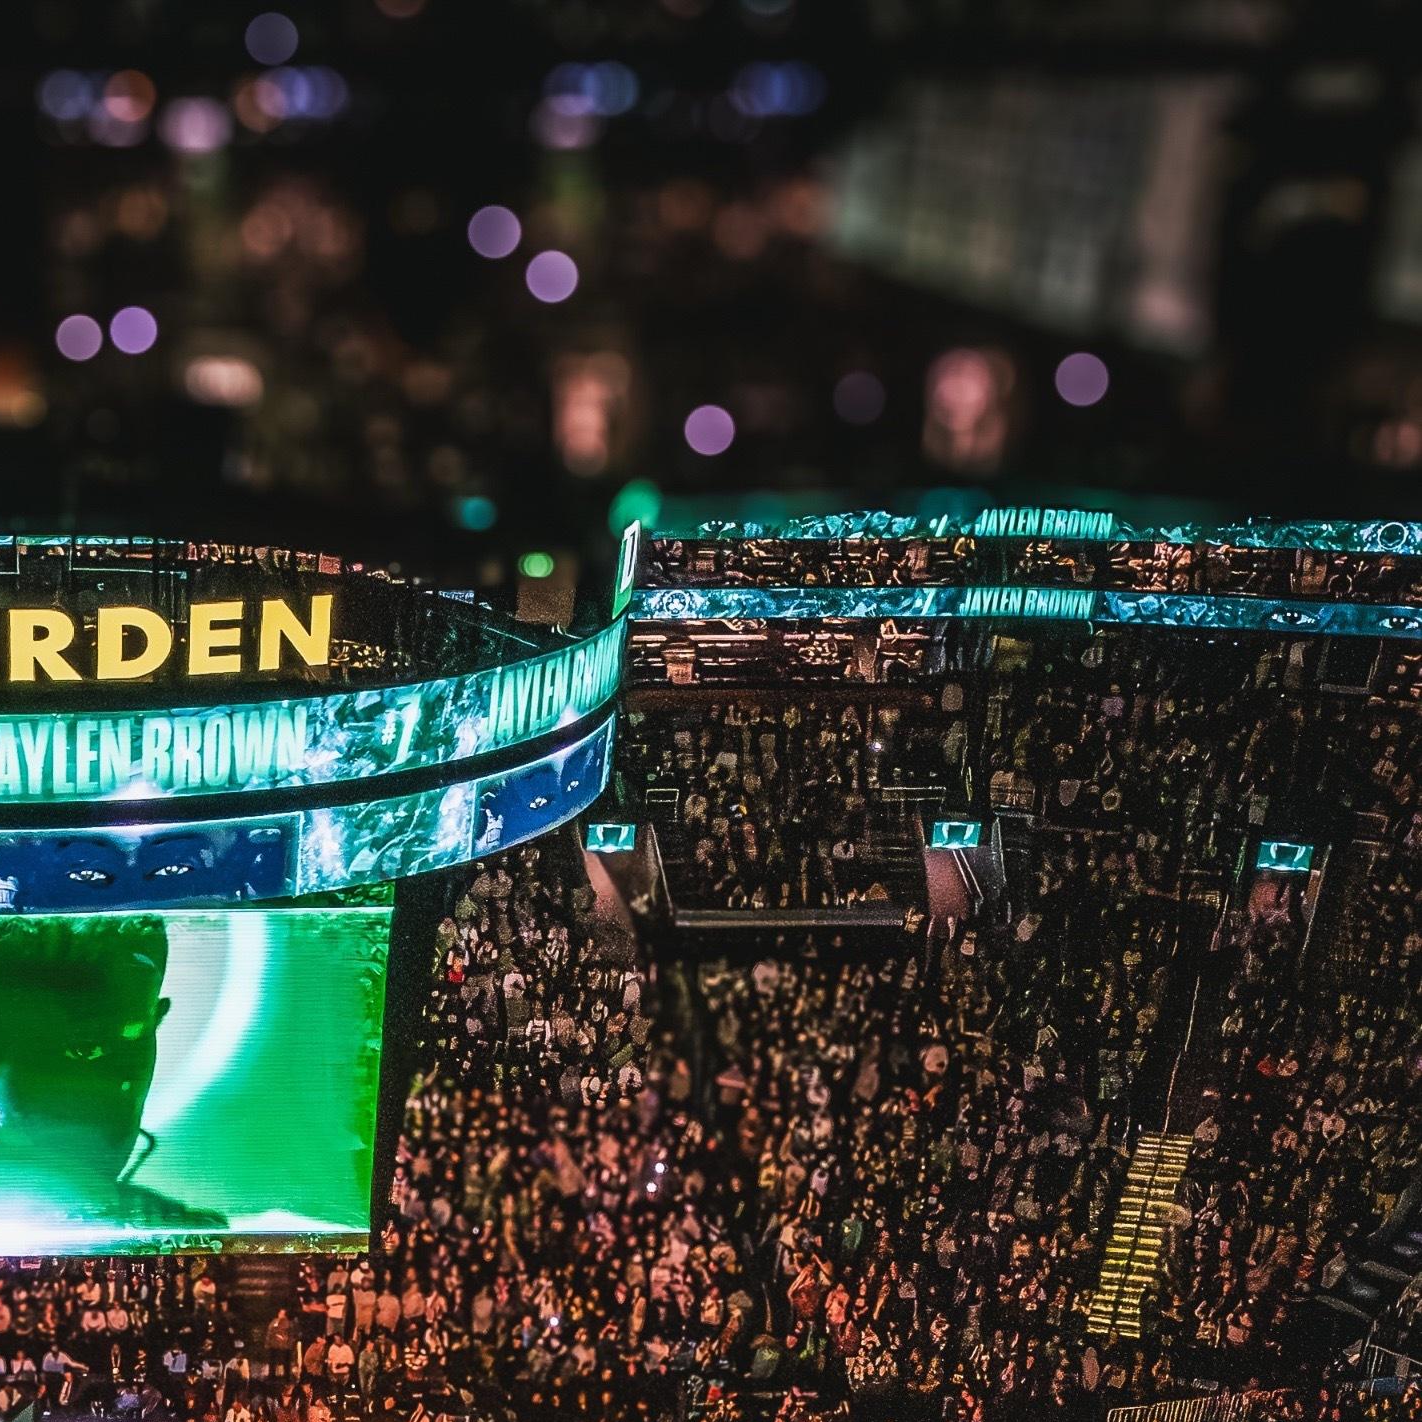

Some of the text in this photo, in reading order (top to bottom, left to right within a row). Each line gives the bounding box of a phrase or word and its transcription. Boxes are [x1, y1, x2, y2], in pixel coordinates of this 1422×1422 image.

[974, 508, 1040, 537] JAYLEN
[1041, 508, 1114, 539] BROWN
[959, 587, 1023, 617] JAYLEN
[1023, 589, 1094, 619] BROWN
[141, 704, 308, 787] BROWN
[381, 692, 422, 764] #7
[482, 652, 570, 741] JAYLEN
